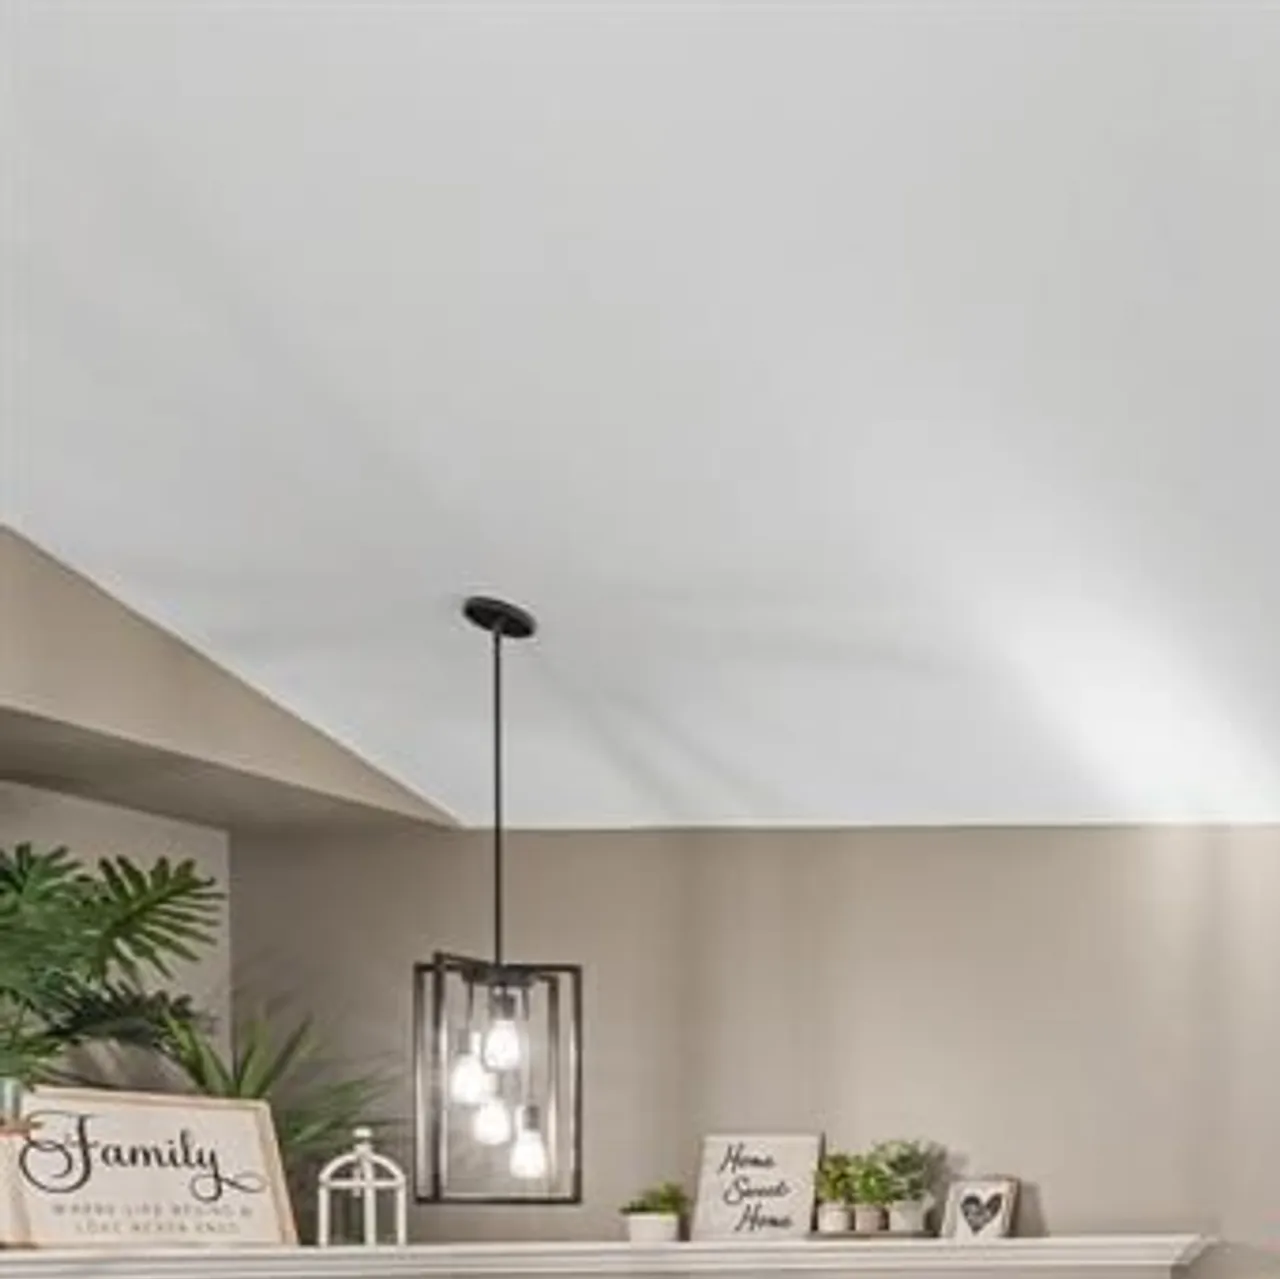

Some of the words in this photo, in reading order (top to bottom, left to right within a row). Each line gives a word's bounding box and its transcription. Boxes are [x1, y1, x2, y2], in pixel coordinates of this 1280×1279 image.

[19, 1110, 268, 1202] Family
[718, 1142, 776, 1174] Home
[723, 1176, 792, 1205] Sweet
[734, 1203, 795, 1232] Home
